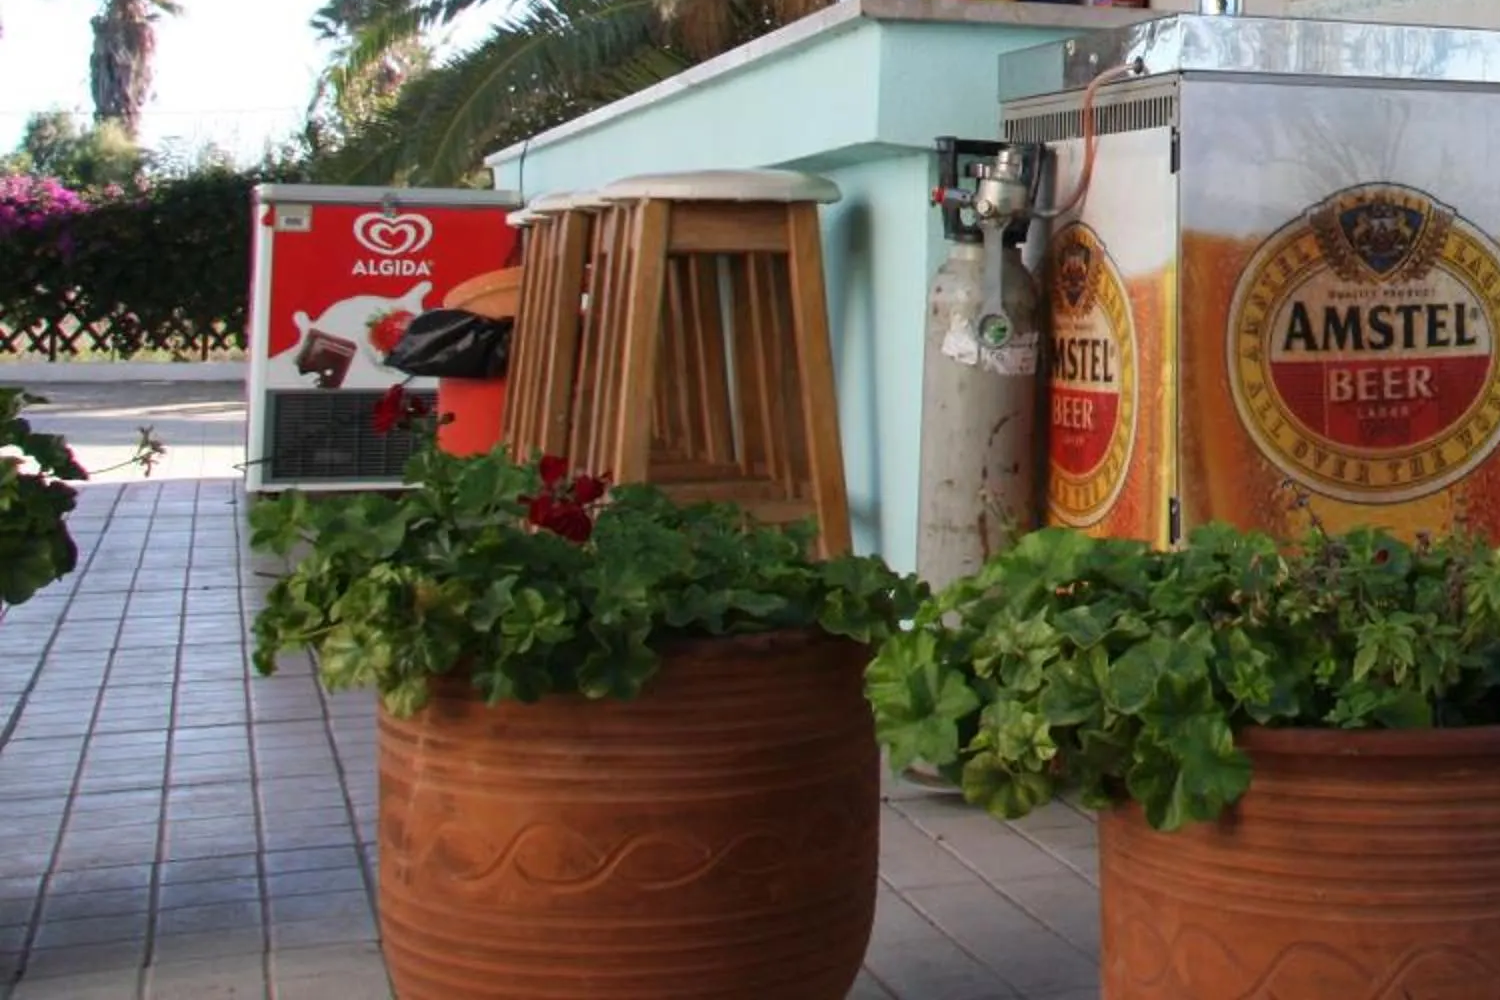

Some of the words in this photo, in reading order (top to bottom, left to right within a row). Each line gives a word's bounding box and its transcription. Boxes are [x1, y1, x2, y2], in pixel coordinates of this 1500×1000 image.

[351, 259, 432, 276] ALGIDA
[1282, 301, 1476, 353] AMSTEL
[1049, 337, 1113, 383] MSTEL
[1329, 363, 1434, 402] BEER
[1053, 396, 1093, 430] BEER
[1294, 439, 1370, 485] OVER
[1387, 449, 1446, 483] THE
